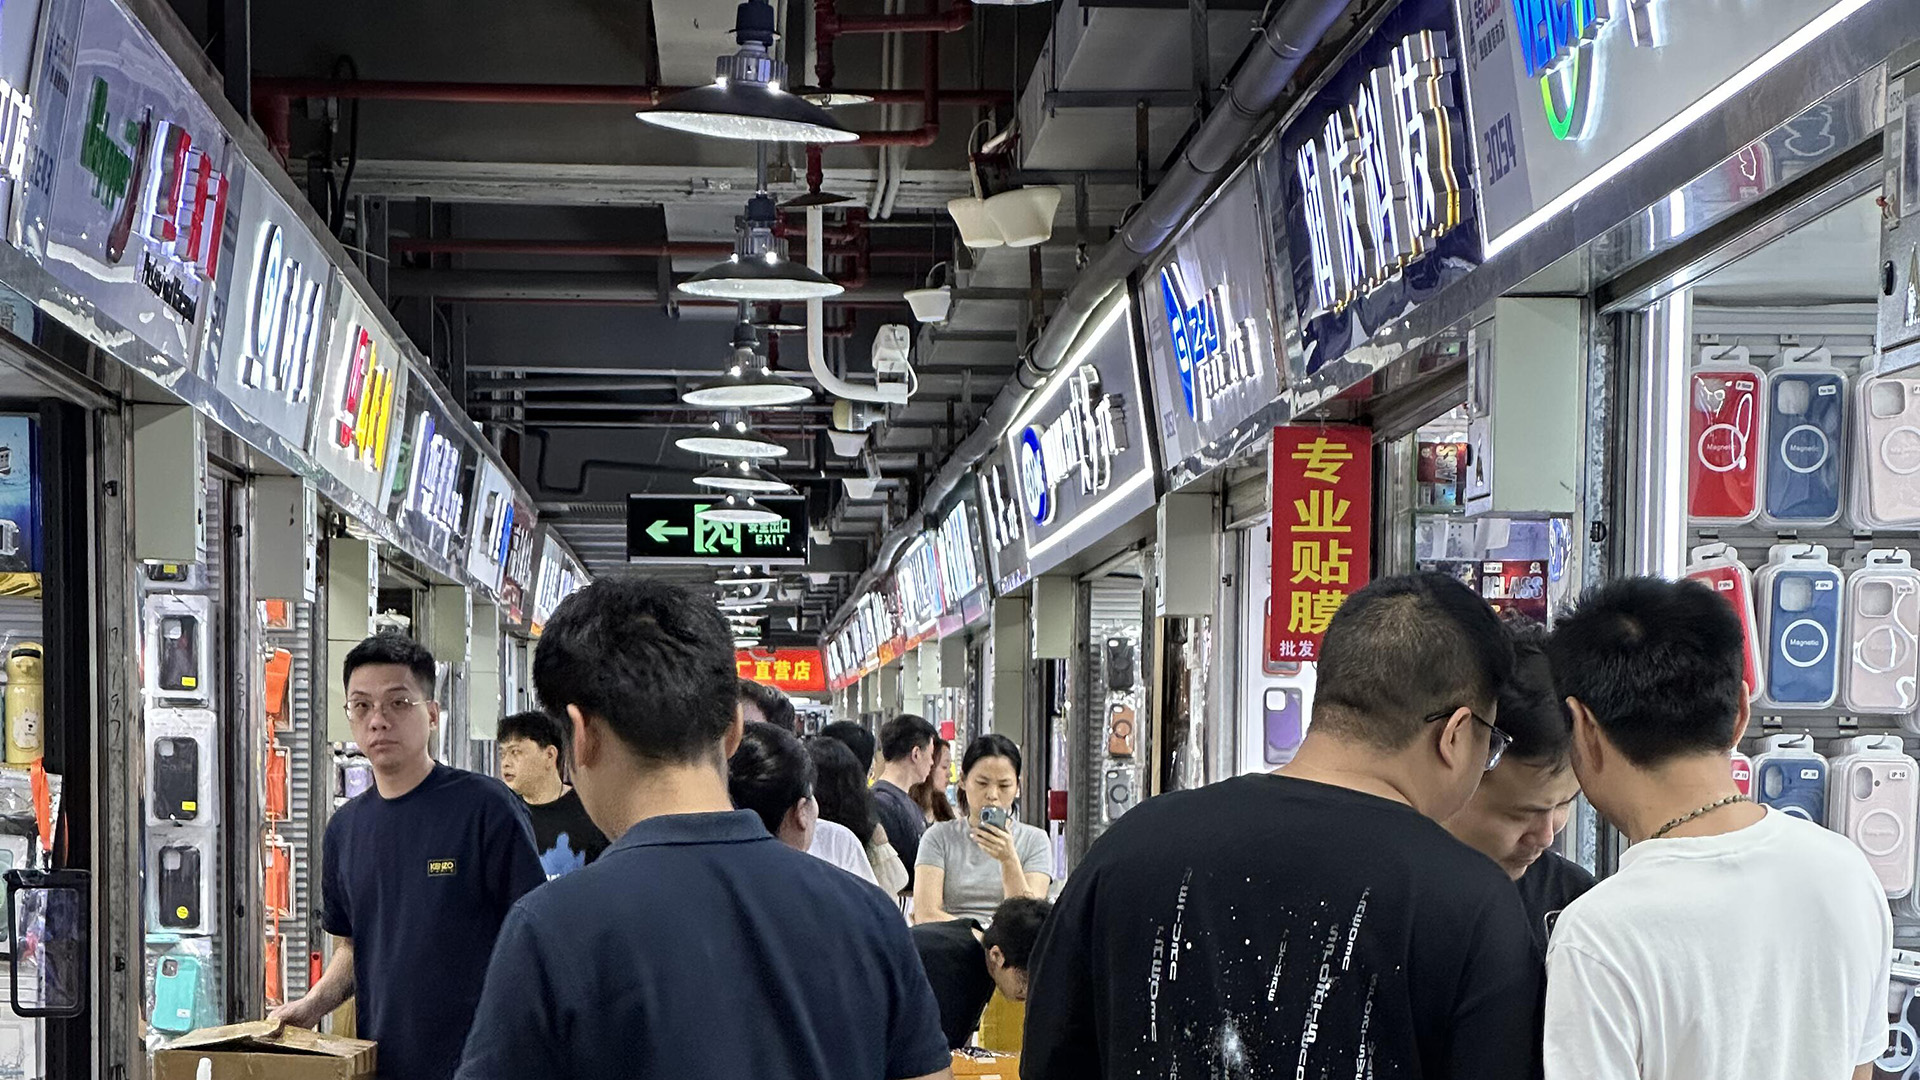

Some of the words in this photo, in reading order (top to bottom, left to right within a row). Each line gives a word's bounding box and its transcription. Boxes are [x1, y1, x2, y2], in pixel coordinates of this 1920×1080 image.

[1484, 112, 1517, 186] 3054
[1298, 34, 1440, 311] 润发科技
[1706, 442, 1737, 452] Magnetc
[1789, 443, 1819, 453] Magnetic
[755, 534, 785, 545] EXIT
[1287, 437, 1353, 634] 专业贴膜
[1280, 640, 1314, 657] 批发
[1790, 638, 1819, 647] Magnetic
